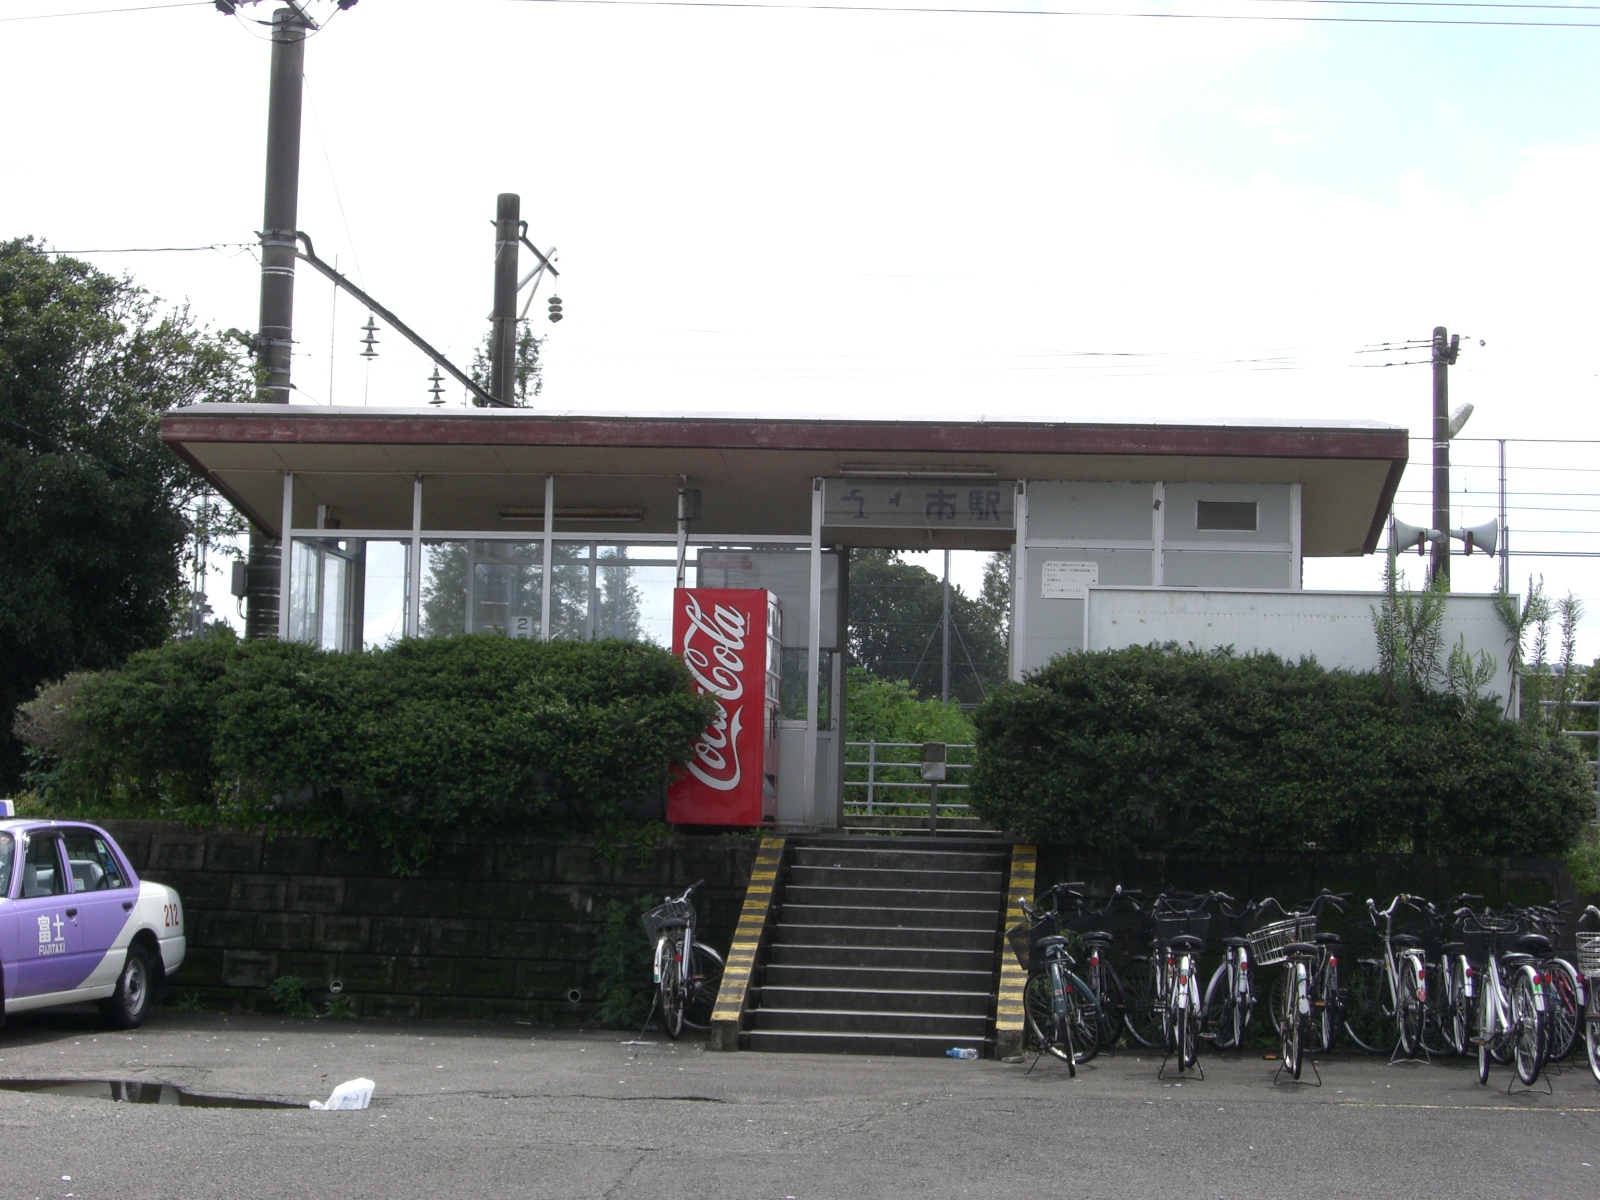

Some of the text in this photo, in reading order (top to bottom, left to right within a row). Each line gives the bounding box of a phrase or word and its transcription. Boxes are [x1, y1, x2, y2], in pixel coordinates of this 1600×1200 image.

[518, 618, 528, 630] 2
[164, 903, 178, 927] 212
[37, 913, 65, 943] 富士
[38, 942, 65, 955] FUJITAXI
